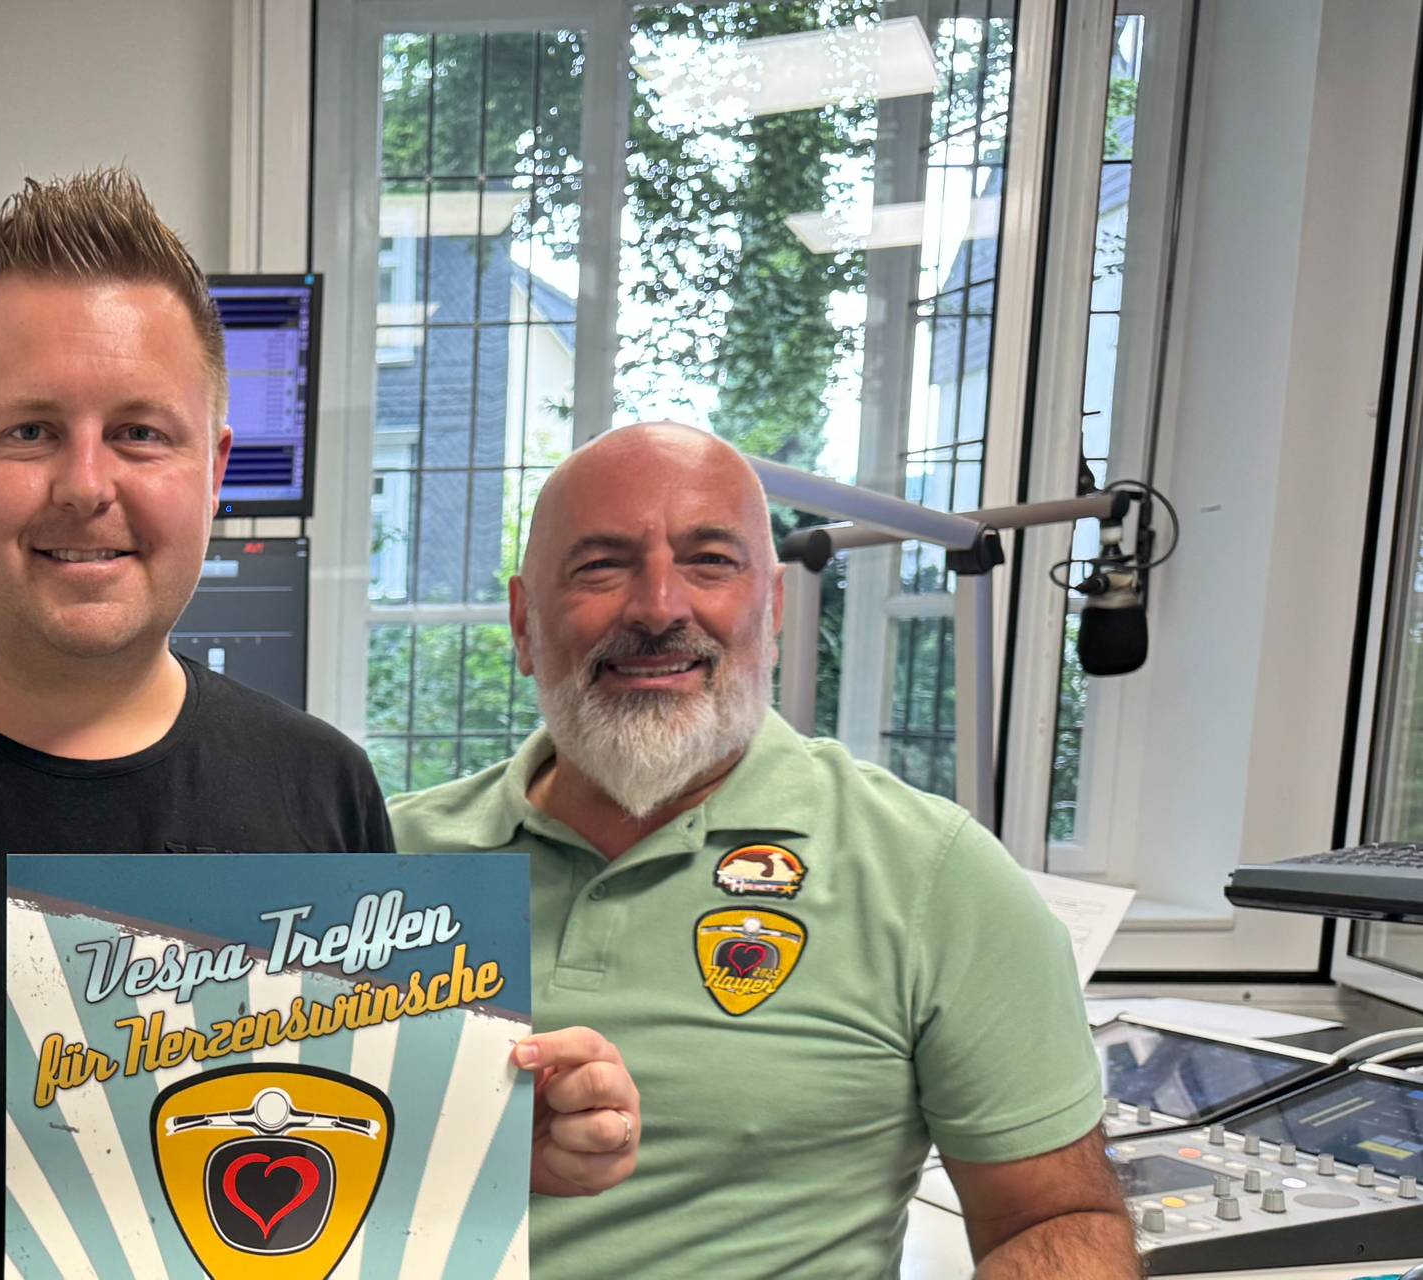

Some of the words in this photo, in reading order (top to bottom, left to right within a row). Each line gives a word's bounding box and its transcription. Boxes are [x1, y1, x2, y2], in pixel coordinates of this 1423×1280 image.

[76, 935, 253, 1005] Vespa
[259, 888, 461, 976] Treffen
[33, 1032, 118, 1108] für
[115, 943, 505, 1077] Herzenswünsche
